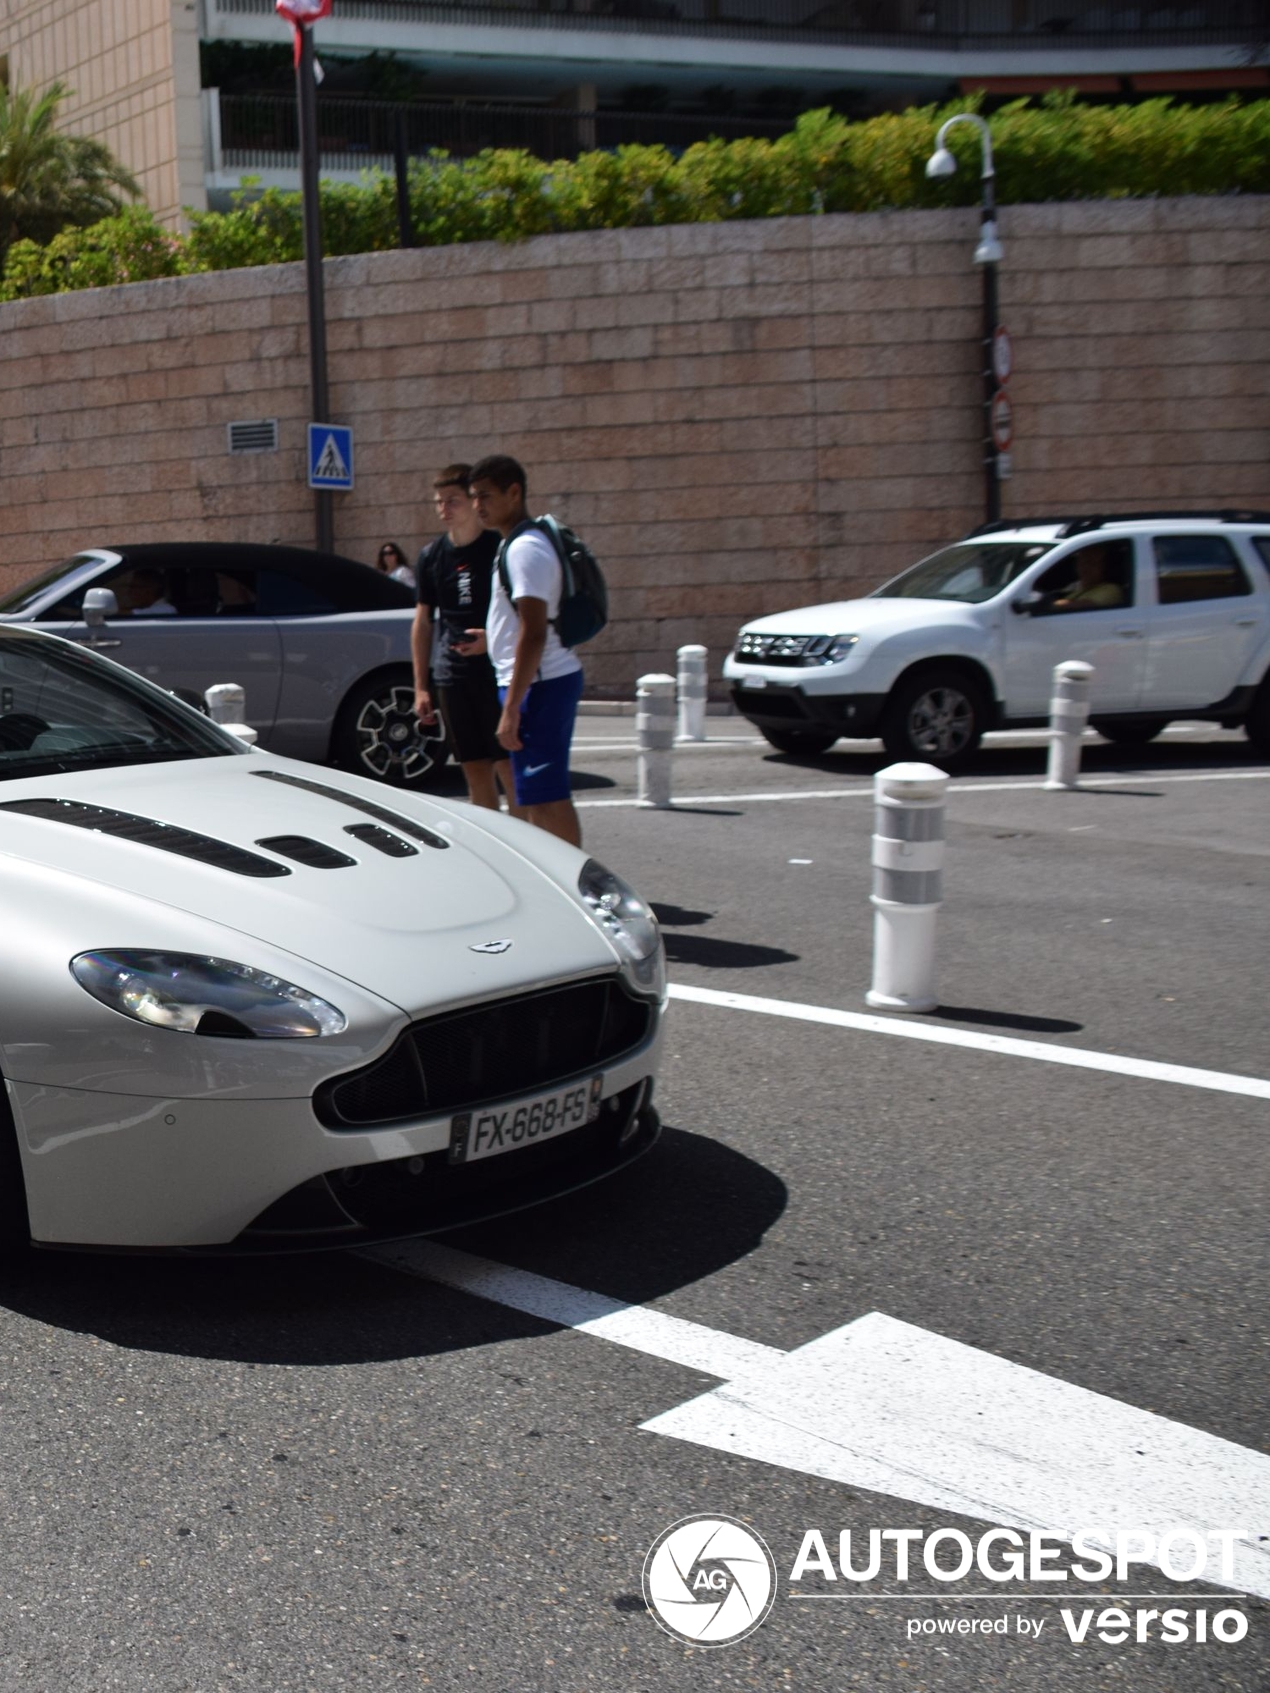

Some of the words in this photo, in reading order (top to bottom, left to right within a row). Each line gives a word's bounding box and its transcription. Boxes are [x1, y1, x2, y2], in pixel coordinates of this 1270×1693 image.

[458, 572, 472, 605] NIKE
[474, 1088, 586, 1152] FX-668-FS
[454, 1143, 463, 1157] F
